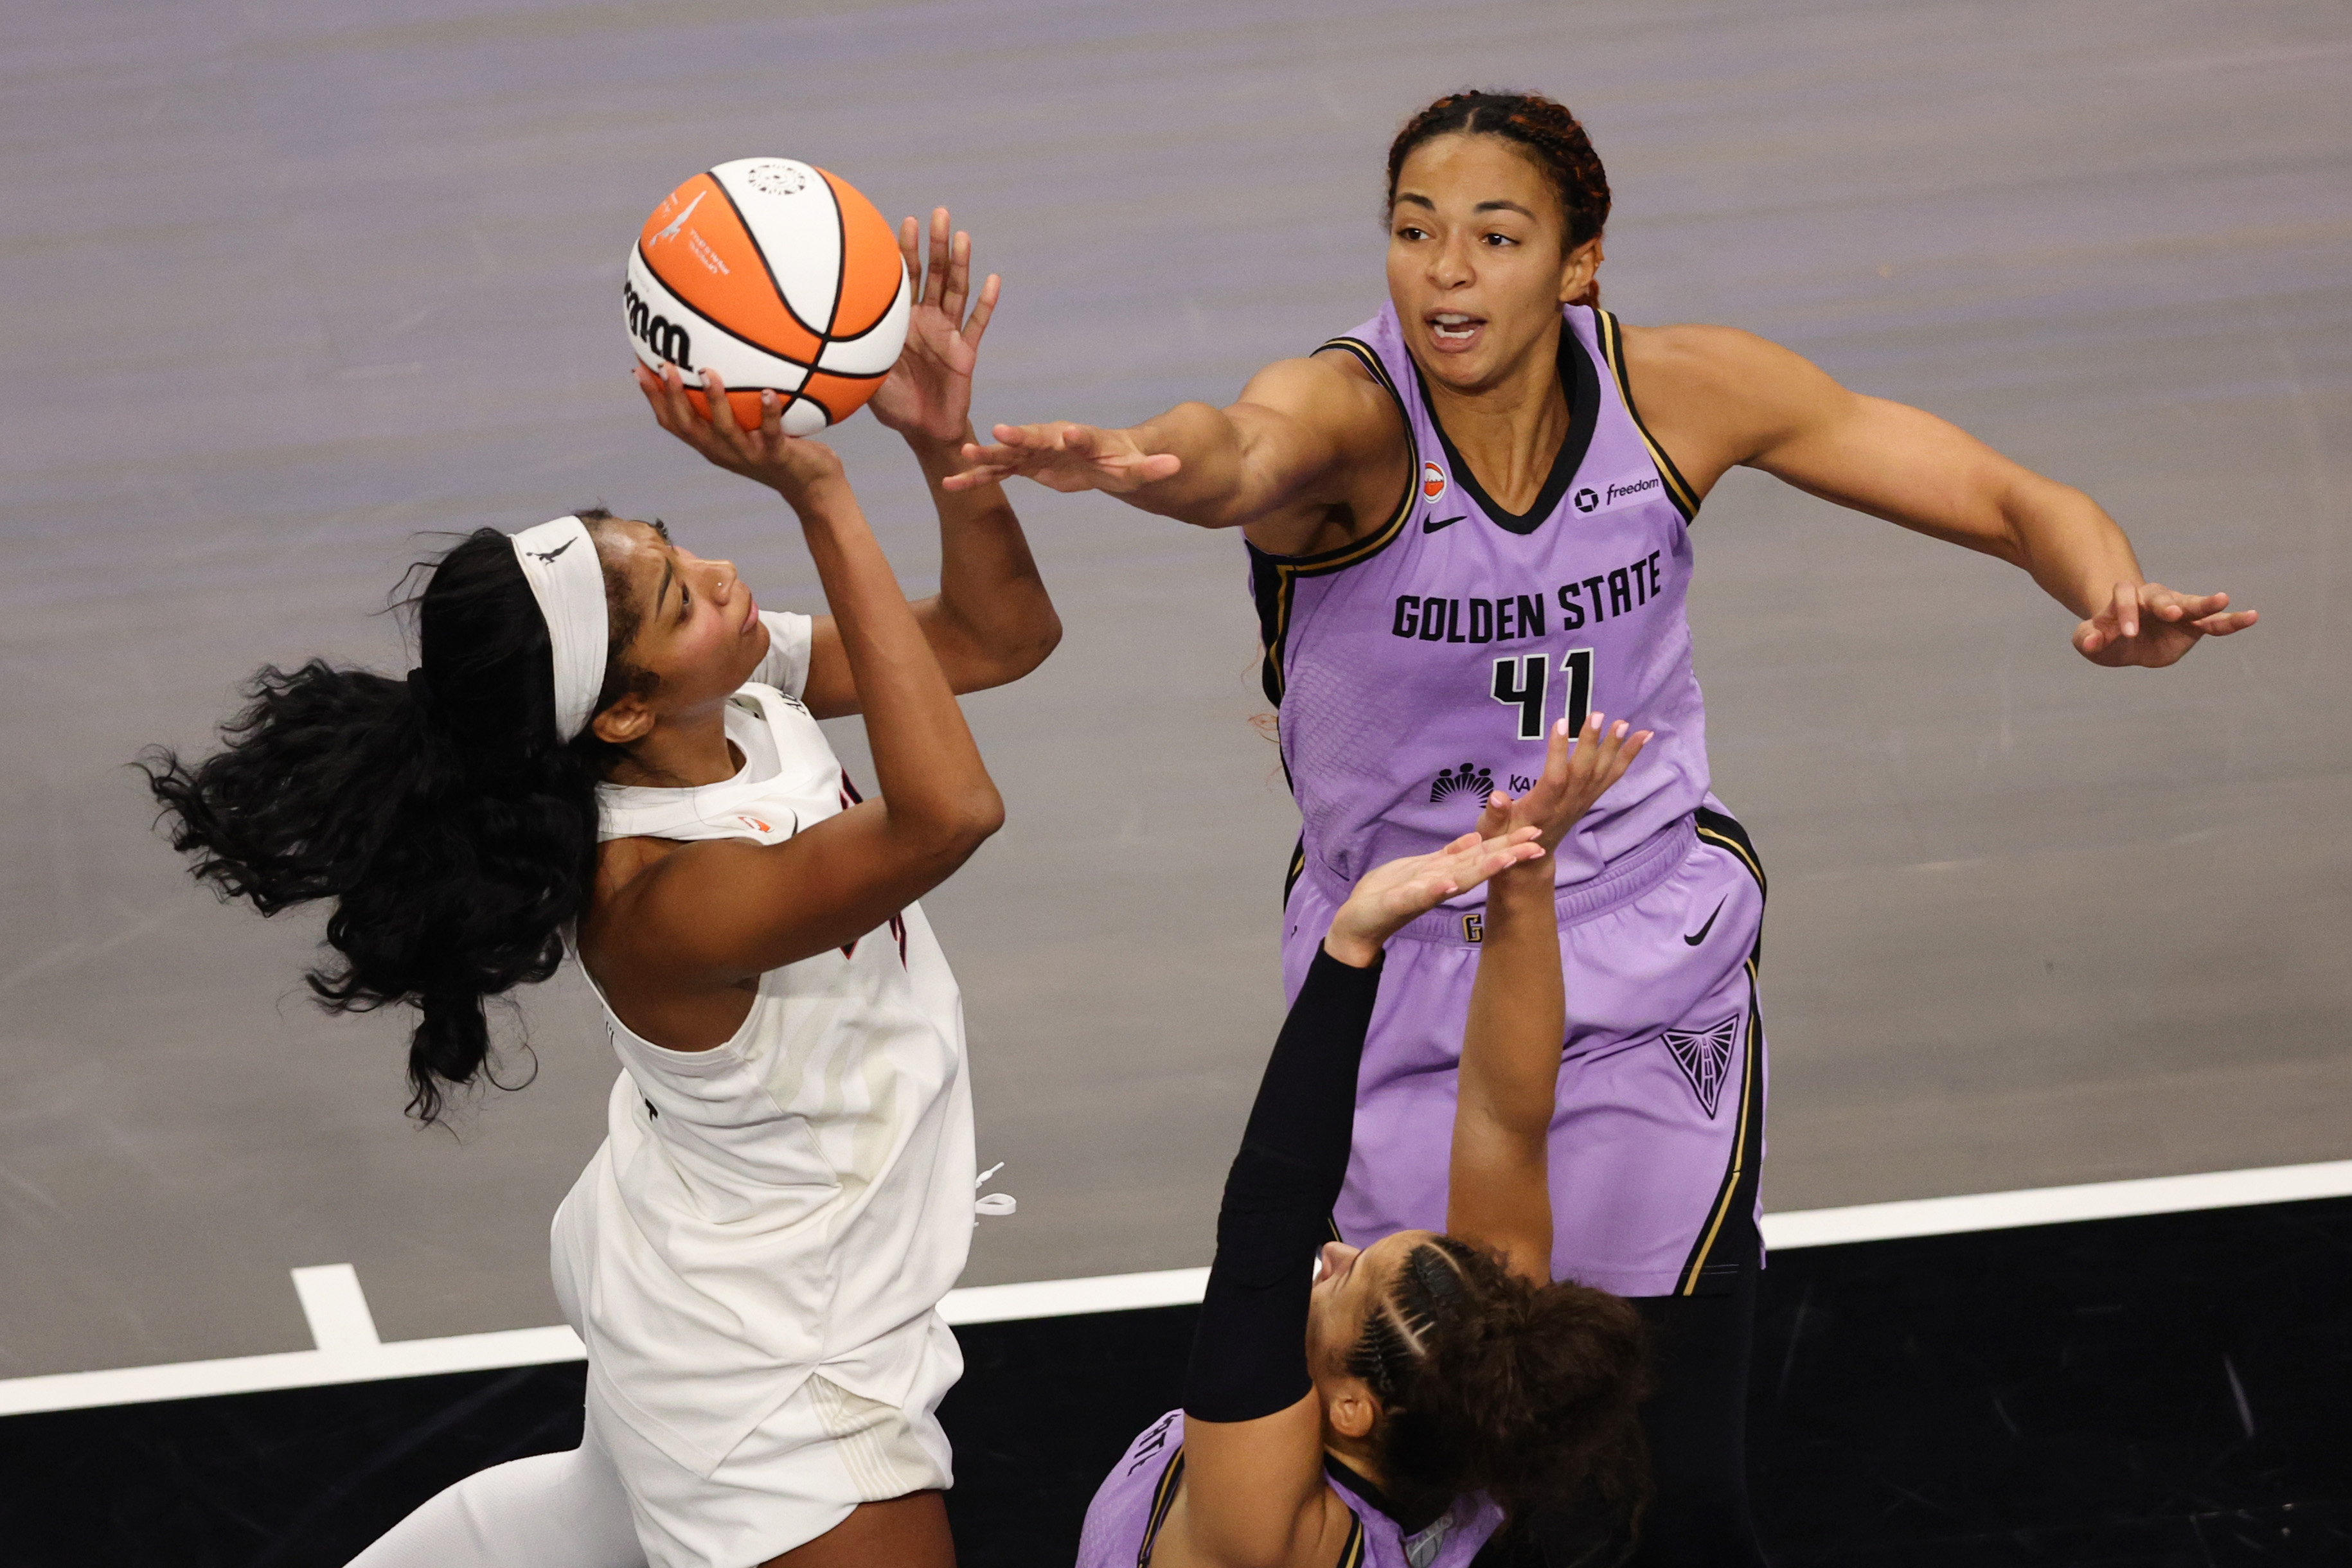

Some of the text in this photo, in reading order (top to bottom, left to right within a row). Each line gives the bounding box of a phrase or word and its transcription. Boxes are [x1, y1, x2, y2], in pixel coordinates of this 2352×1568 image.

[1607, 478, 1659, 506] freedom
[1392, 549, 1661, 643] GOLDEN STATE
[1490, 647, 1594, 742] 41
